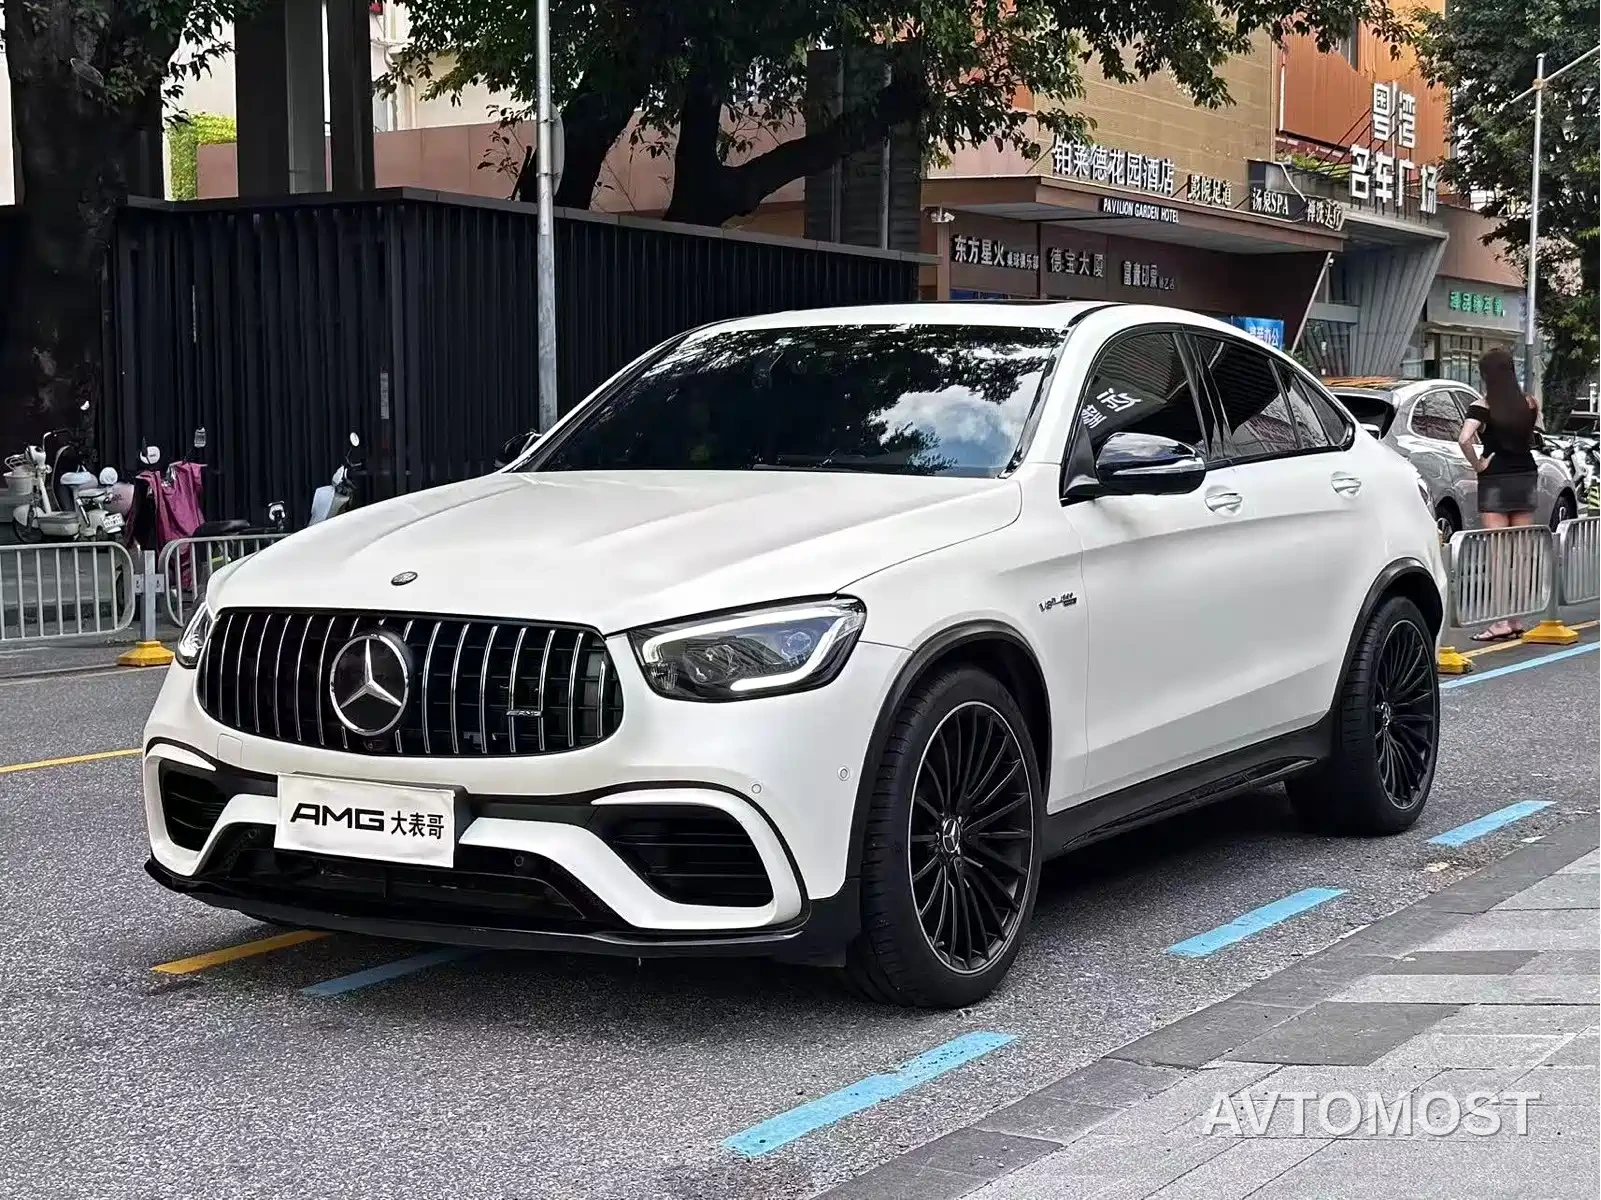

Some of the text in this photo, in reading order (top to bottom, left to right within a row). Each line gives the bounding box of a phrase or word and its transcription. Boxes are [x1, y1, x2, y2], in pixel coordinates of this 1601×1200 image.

[1103, 198, 1180, 224] PAVILION GARDEN HOTEL
[954, 234, 1005, 266] 东方星火
[1050, 247, 1104, 278] 德宝大厦
[290, 802, 445, 840] AMG 大表哥
